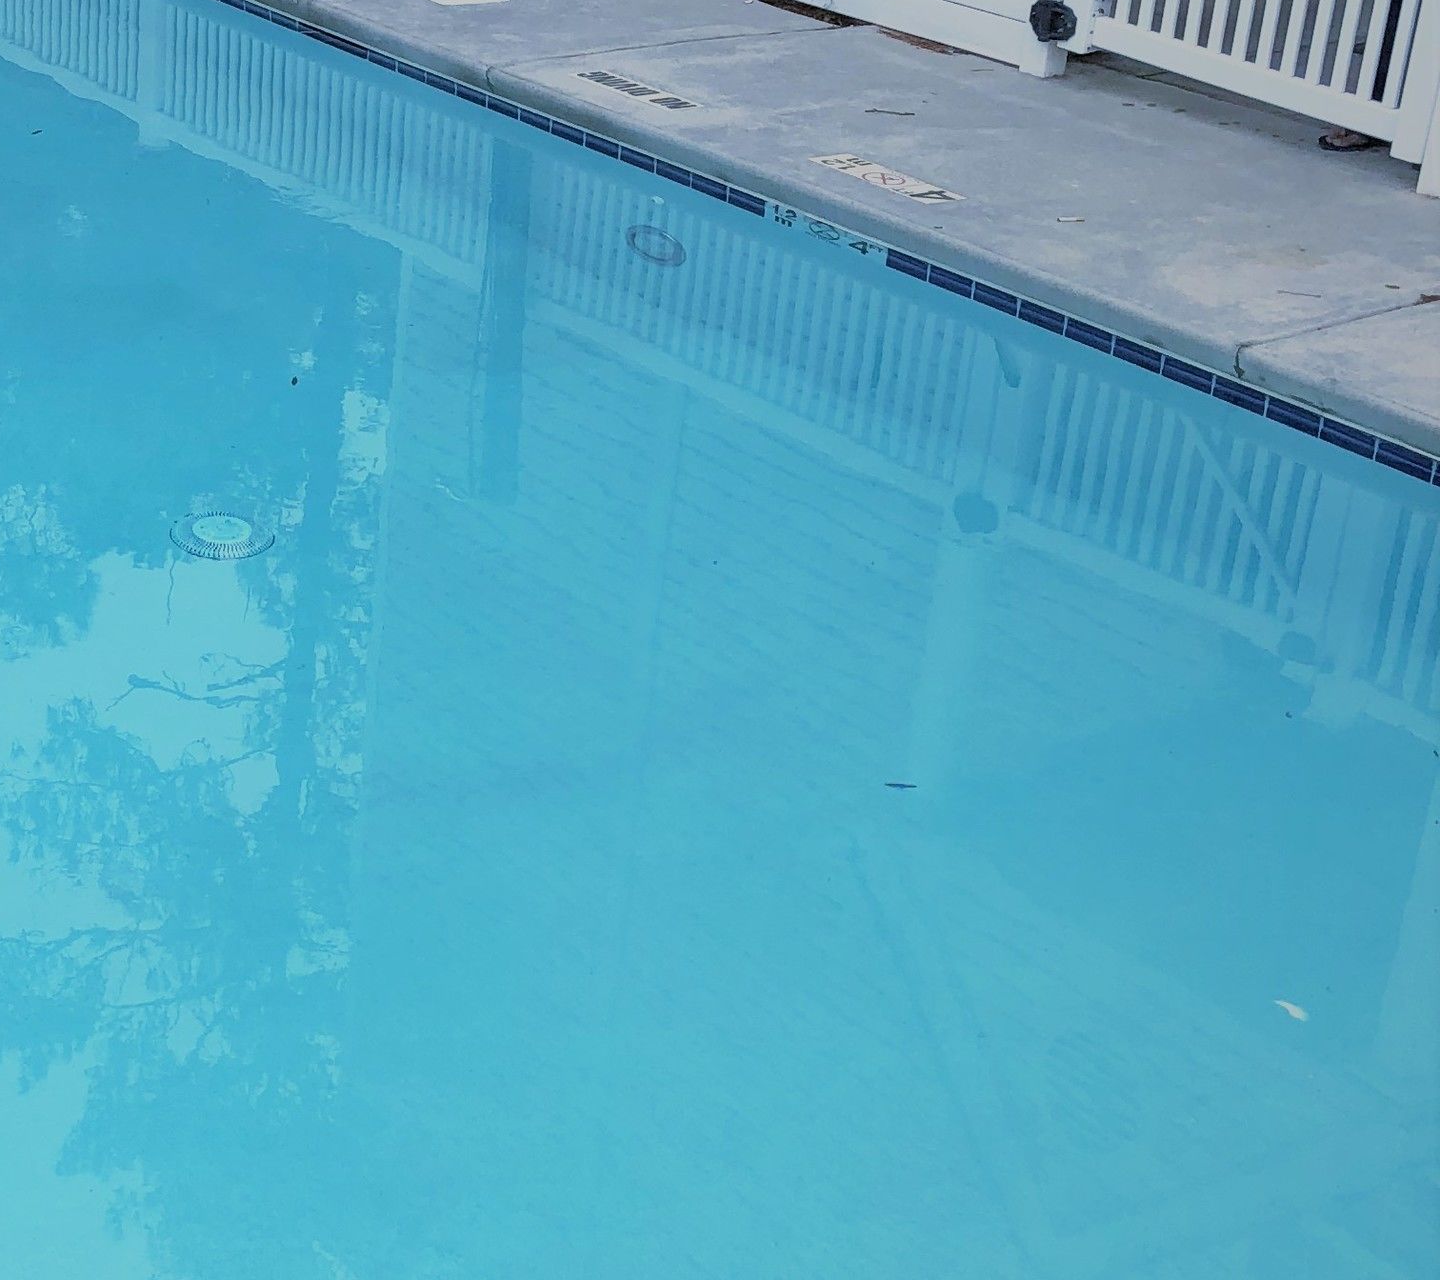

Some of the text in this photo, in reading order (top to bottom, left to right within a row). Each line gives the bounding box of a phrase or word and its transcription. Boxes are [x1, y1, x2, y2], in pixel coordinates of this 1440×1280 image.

[577, 71, 698, 109] NO DIVING
[848, 240, 870, 255] 4
